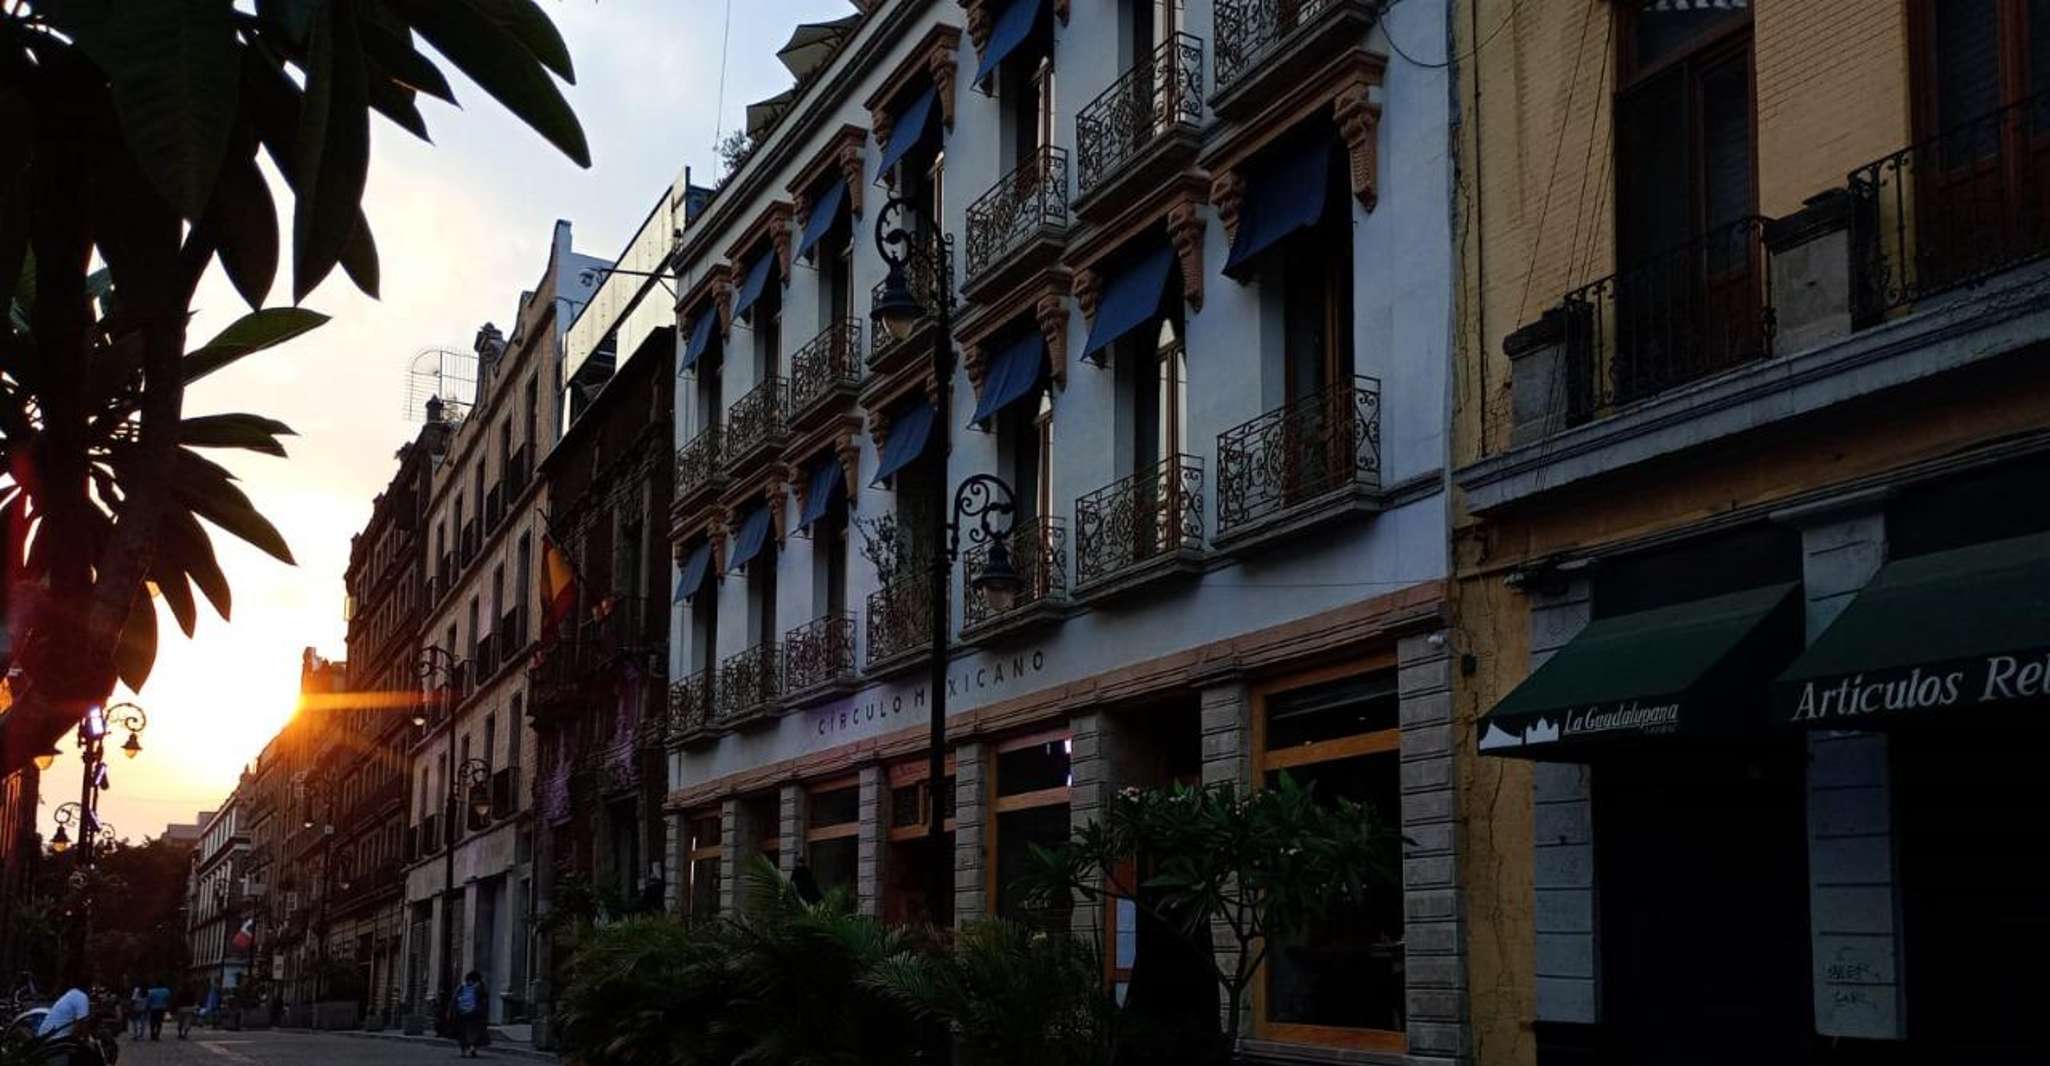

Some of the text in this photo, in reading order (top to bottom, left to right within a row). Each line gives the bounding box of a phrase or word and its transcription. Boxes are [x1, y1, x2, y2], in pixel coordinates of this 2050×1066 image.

[914, 651, 1044, 707] MXICANO
[1562, 701, 1680, 734] La Guadalupana
